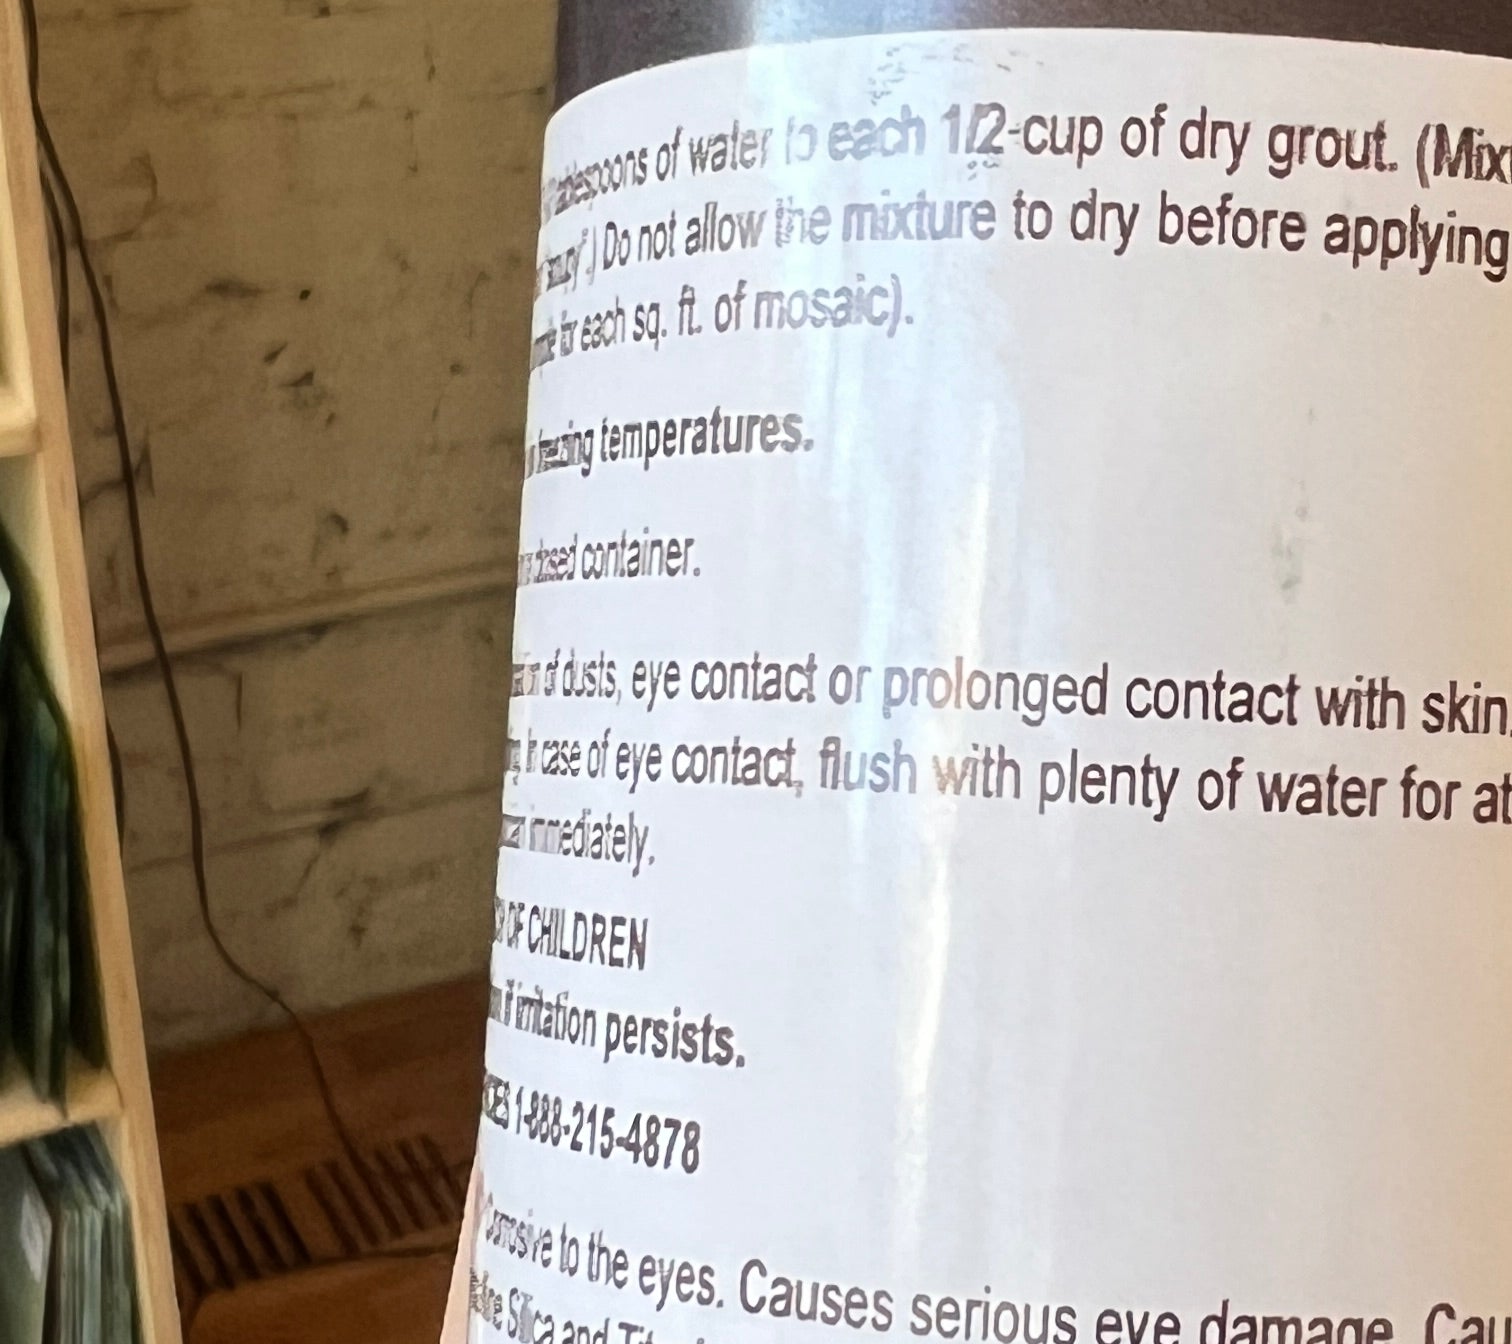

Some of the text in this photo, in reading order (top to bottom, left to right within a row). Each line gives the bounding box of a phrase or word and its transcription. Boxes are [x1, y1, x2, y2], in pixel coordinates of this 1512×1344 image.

[656, 125, 684, 181] of
[689, 120, 773, 176] water
[828, 104, 926, 161] each
[1121, 103, 1168, 156] of
[1180, 106, 1251, 176] dry
[1268, 119, 1398, 179] grout.
[603, 220, 630, 271] Do
[638, 210, 675, 263] not
[685, 201, 767, 255] allow
[841, 189, 996, 242] mixture
[1013, 189, 1052, 240] to
[1070, 188, 1140, 256] dry
[1159, 190, 1307, 252] before
[1324, 205, 1510, 283] applying
[581, 296, 625, 352] each
[633, 302, 667, 352] sq.
[679, 284, 702, 336] ft.
[715, 280, 747, 333] of
[754, 273, 914, 338] mosaic).
[600, 405, 814, 471] temperatures.
[582, 526, 700, 581] container.
[562, 647, 622, 705] dusts,
[632, 659, 680, 712] eye
[691, 650, 817, 703] contact
[829, 663, 872, 705] or
[884, 656, 1108, 727] prolonged
[1126, 669, 1301, 726] contact
[1315, 674, 1406, 730] with
[542, 739, 581, 777] case
[588, 727, 612, 778] of
[616, 741, 662, 794] eye
[672, 735, 803, 798] contact,
[819, 736, 917, 794] flush
[932, 743, 1021, 799] with
[1039, 748, 1180, 822] plenty
[1198, 757, 1244, 810] of
[1257, 763, 1388, 817] water
[1400, 764, 1462, 821] for
[1472, 772, 1512, 825] at
[528, 905, 649, 971] CHILDREN
[603, 1006, 745, 1067] persists.
[515, 1086, 701, 1174] 1-888-215-4878
[560, 1222, 579, 1277] to
[588, 1229, 629, 1289] the
[639, 1254, 724, 1312] eyes.
[740, 1258, 893, 1332] Causes
